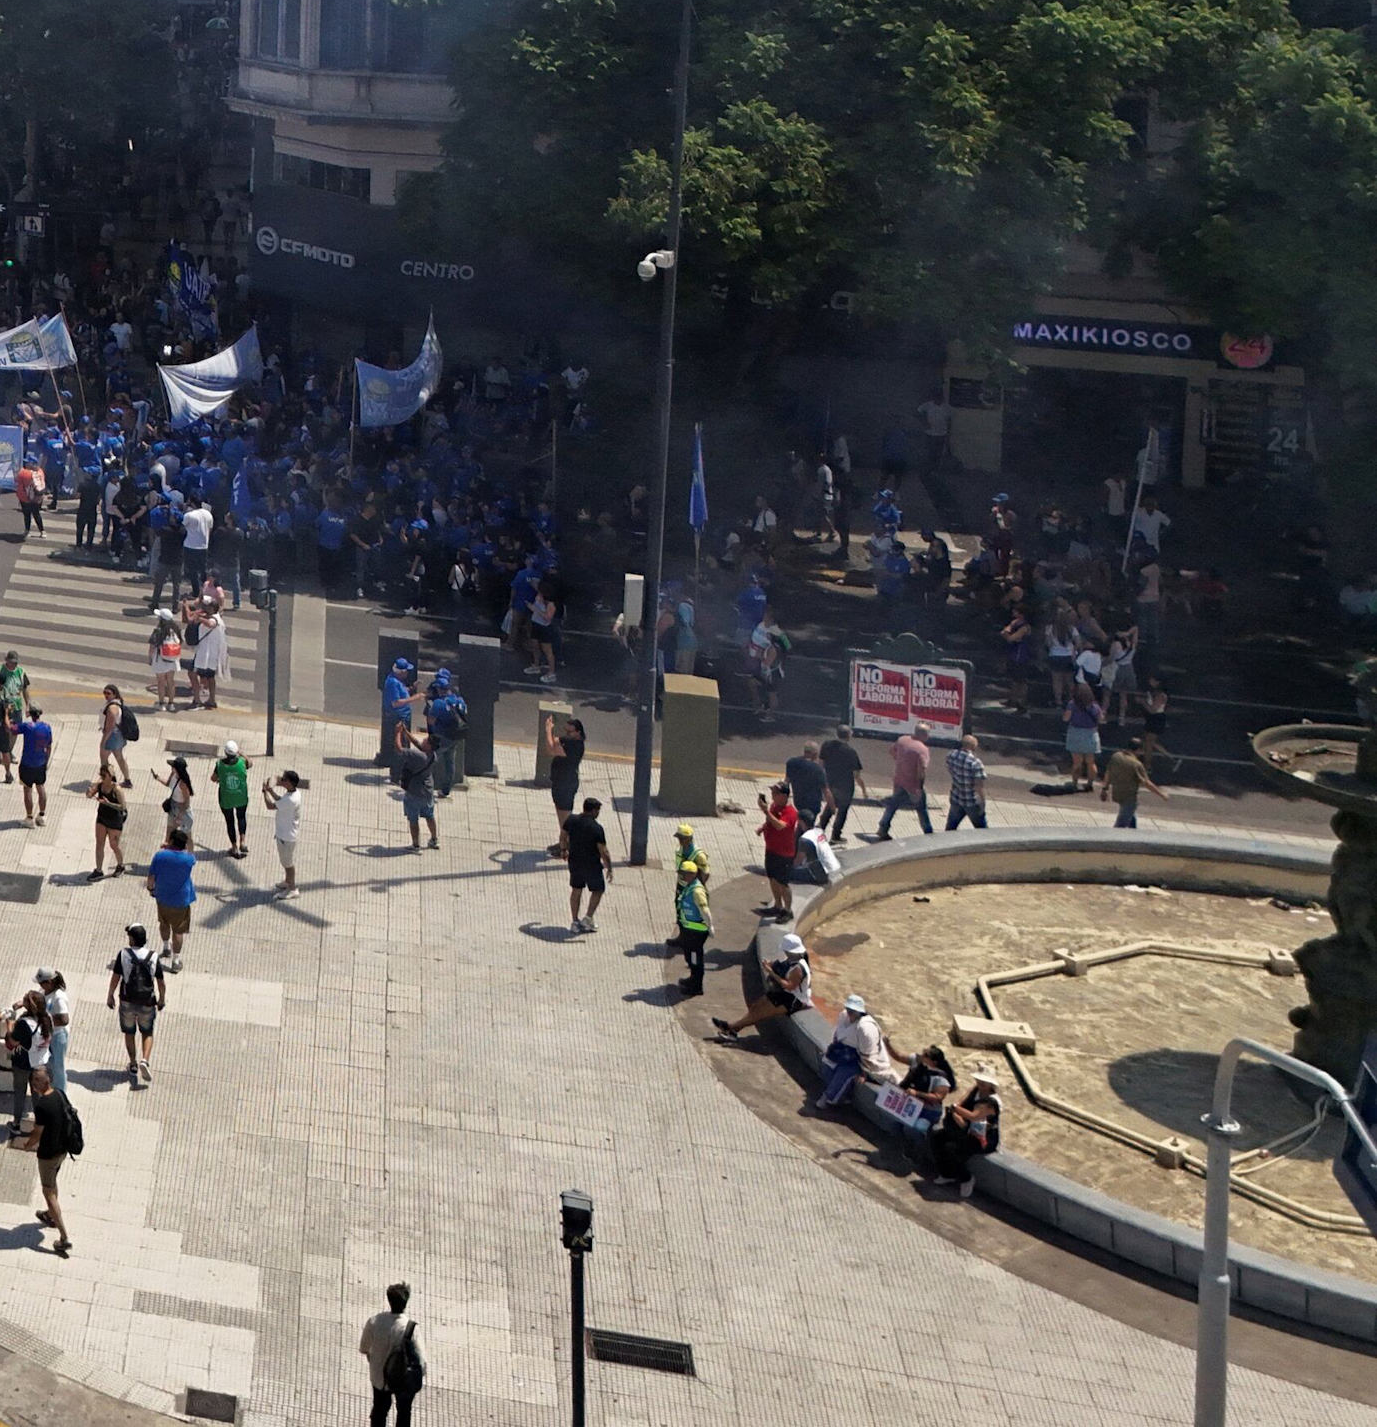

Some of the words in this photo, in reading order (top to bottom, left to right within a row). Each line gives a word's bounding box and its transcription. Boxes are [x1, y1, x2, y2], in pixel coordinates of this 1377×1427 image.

[280, 238, 356, 268] CFMOTO
[400, 260, 475, 281] CENTRO
[1013, 322, 1192, 351] MAXIKIOSCO
[1267, 428, 1299, 454] 24
[859, 667, 883, 683] NO
[912, 672, 936, 689] NO
[859, 683, 906, 695] REFORMA
[912, 687, 959, 701] REFORMA
[859, 690, 906, 705] LABORAL
[912, 696, 960, 709] LABORAL
